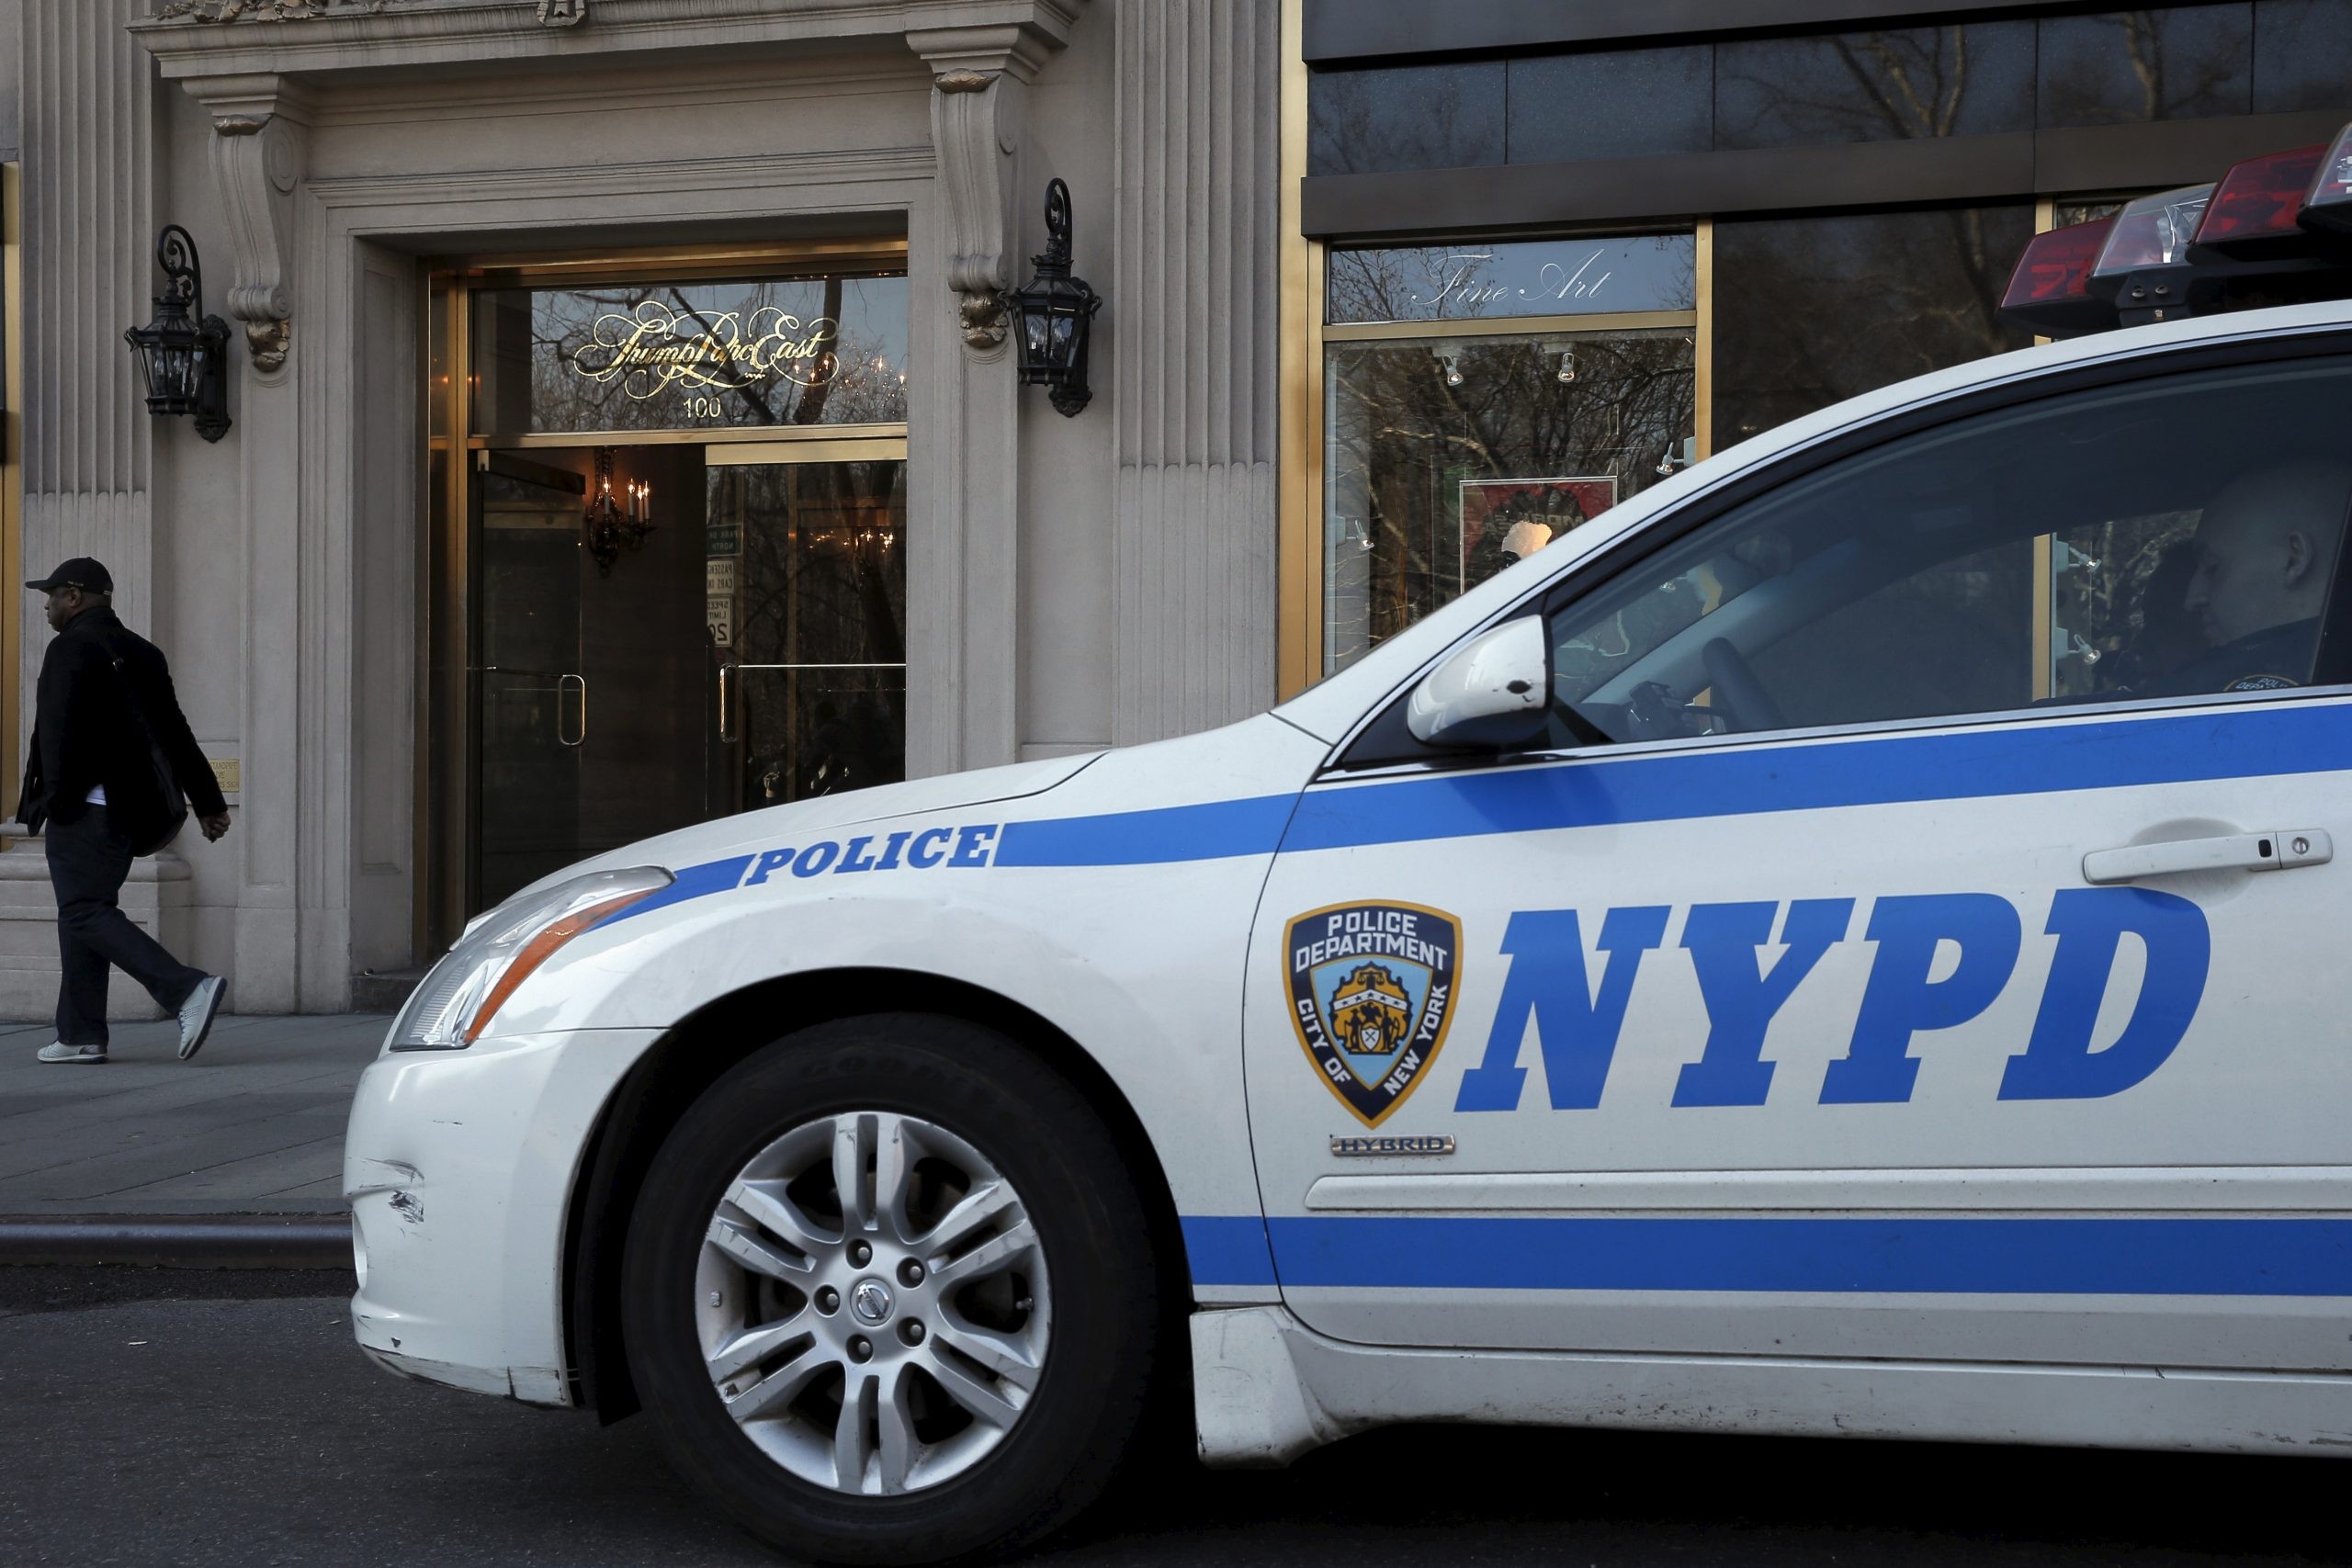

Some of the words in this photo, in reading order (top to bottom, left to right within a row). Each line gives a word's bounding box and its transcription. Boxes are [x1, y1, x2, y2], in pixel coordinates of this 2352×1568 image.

[1411, 254, 1508, 305] Fine
[1518, 248, 1611, 300] Art
[573, 300, 700, 399] Trump
[749, 306, 839, 386] East
[683, 397, 721, 419] 100
[744, 824, 999, 886] POLICE
[1328, 911, 1418, 937] POLICE
[1295, 932, 1448, 974] DEPARTMENT
[1453, 886, 2211, 1111] NYPD
[1297, 998, 1329, 1050] CITY
[1324, 1057, 1351, 1084] OF
[1383, 1049, 1421, 1096] NEW
[1416, 985, 1448, 1042] YORK
[1340, 1137, 1446, 1153] HYBRID
